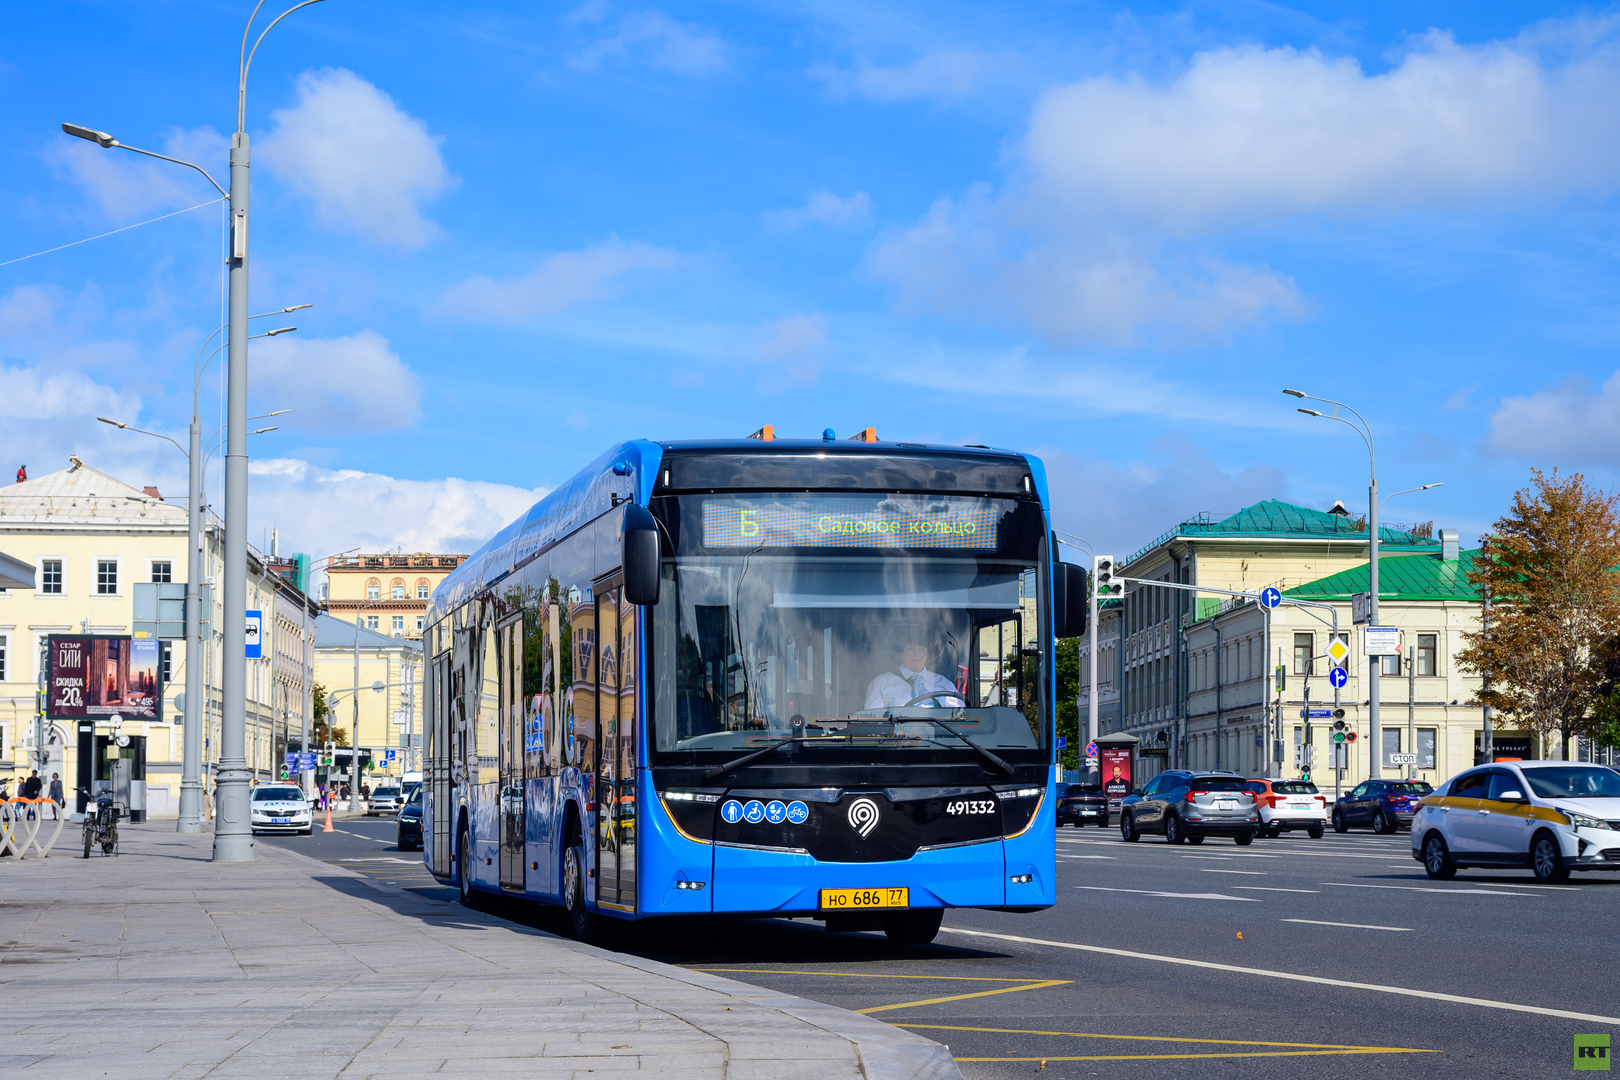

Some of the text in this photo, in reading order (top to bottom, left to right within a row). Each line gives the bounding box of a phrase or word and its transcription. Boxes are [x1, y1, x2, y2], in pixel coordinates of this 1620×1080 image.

[740, 510, 976, 537] Б Садовое кольцо
[59, 649, 81, 668] СИТИ
[55, 677, 83, 687] СКИДКА
[1392, 754, 1414, 763] СТОП
[946, 800, 996, 815] 491332
[829, 889, 903, 906] НО 686 77
